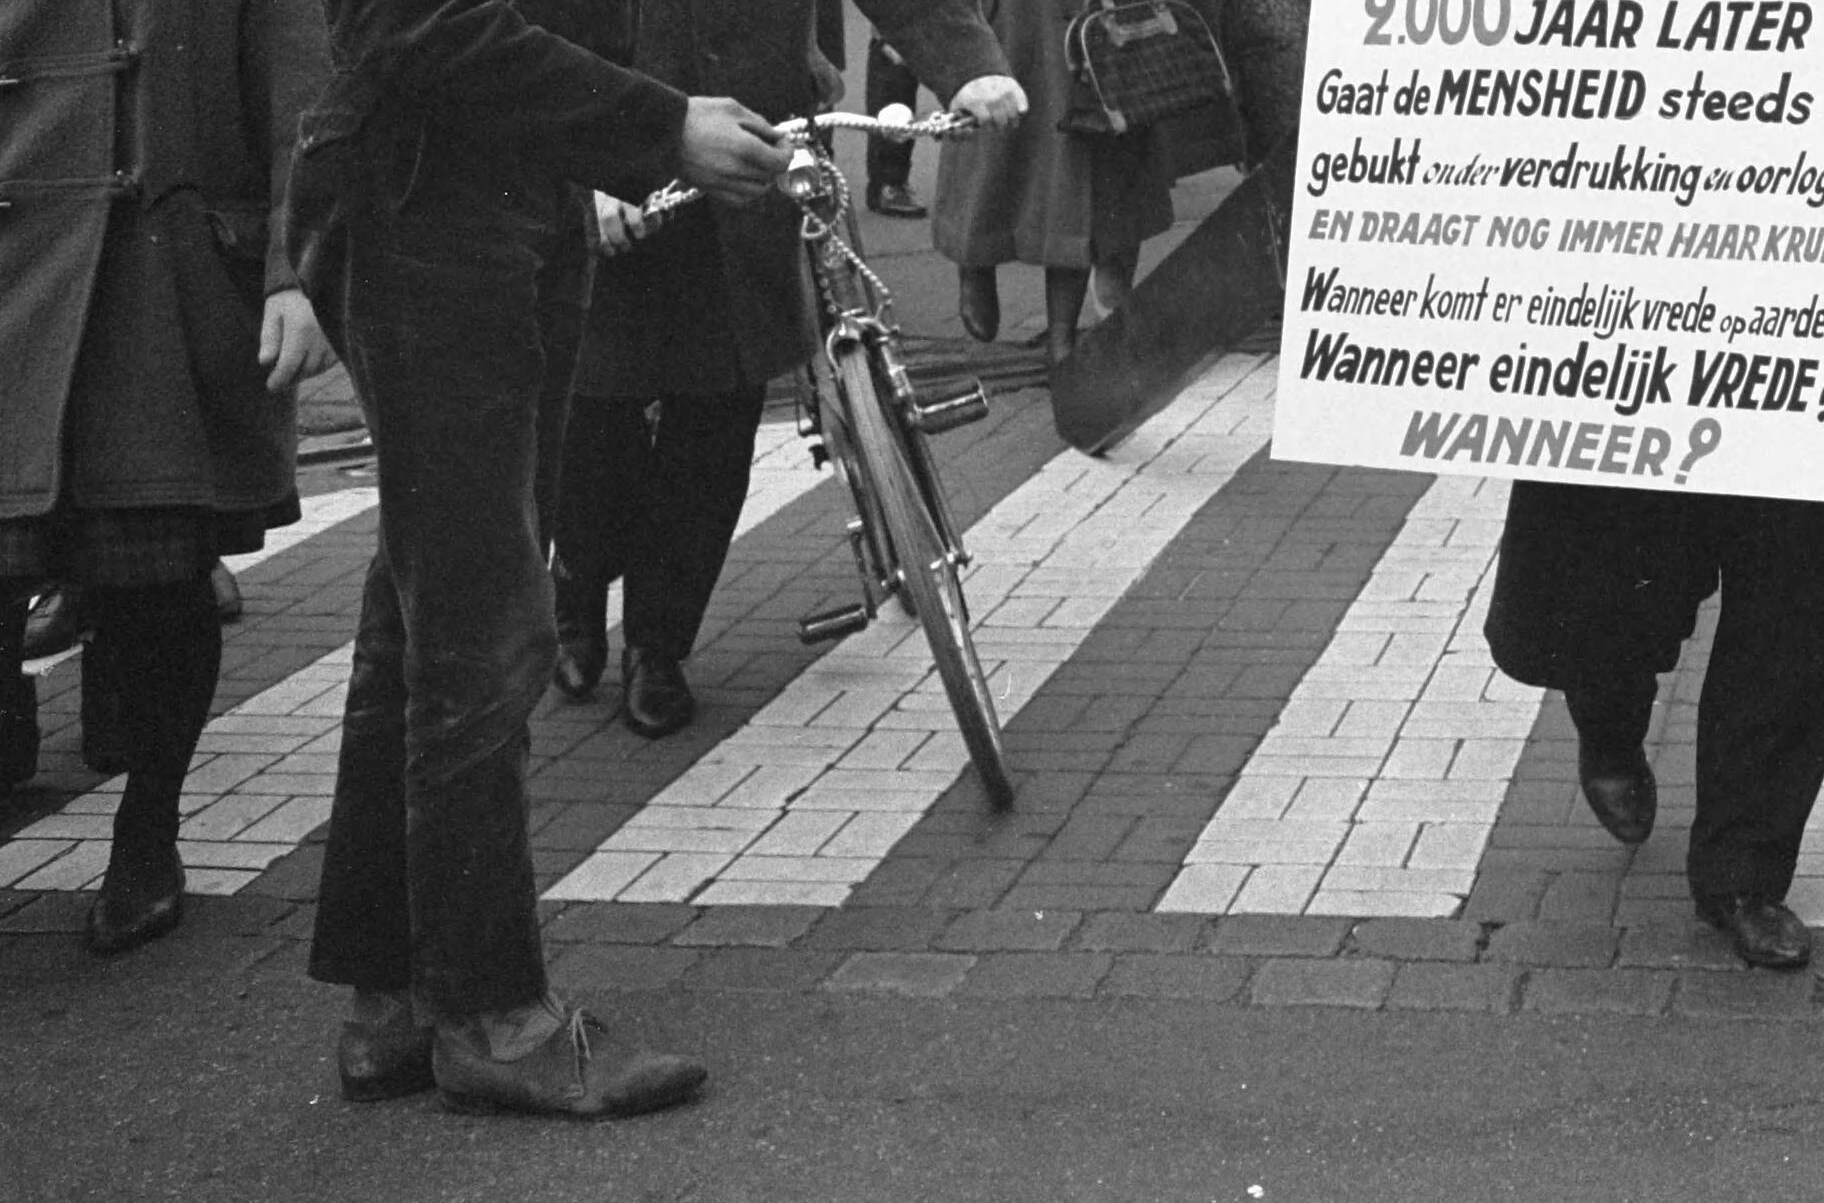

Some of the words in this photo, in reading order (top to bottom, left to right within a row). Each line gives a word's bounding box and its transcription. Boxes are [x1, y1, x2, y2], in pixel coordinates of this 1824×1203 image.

[1514, 0, 1643, 48] JAAR
[1656, 0, 1812, 52] LATER
[1317, 69, 1389, 115] Gaat
[1394, 69, 1430, 115] de
[1434, 69, 1646, 120] MENSHEID
[1659, 71, 1814, 125] steeds
[1307, 137, 1421, 197] gebukt
[1423, 155, 1500, 186] onder
[1500, 142, 1702, 207] verdrukking
[1704, 168, 1733, 191] en
[1309, 210, 1353, 242] EN
[1359, 212, 1480, 245] DRAAGT
[1487, 217, 1550, 250] NOG
[1558, 220, 1662, 255] IMMER
[1667, 223, 1760, 260] HAAR
[1301, 266, 1418, 316] Wanneer
[1419, 274, 1489, 321] komt
[1493, 293, 1522, 322] er
[1527, 282, 1640, 340] eindelijk
[1642, 286, 1716, 333] vrede
[1720, 315, 1746, 343] op
[1300, 328, 1480, 390] Wanneer
[1489, 341, 1677, 416] eindelijk
[1400, 411, 1721, 484] WANNEER?
